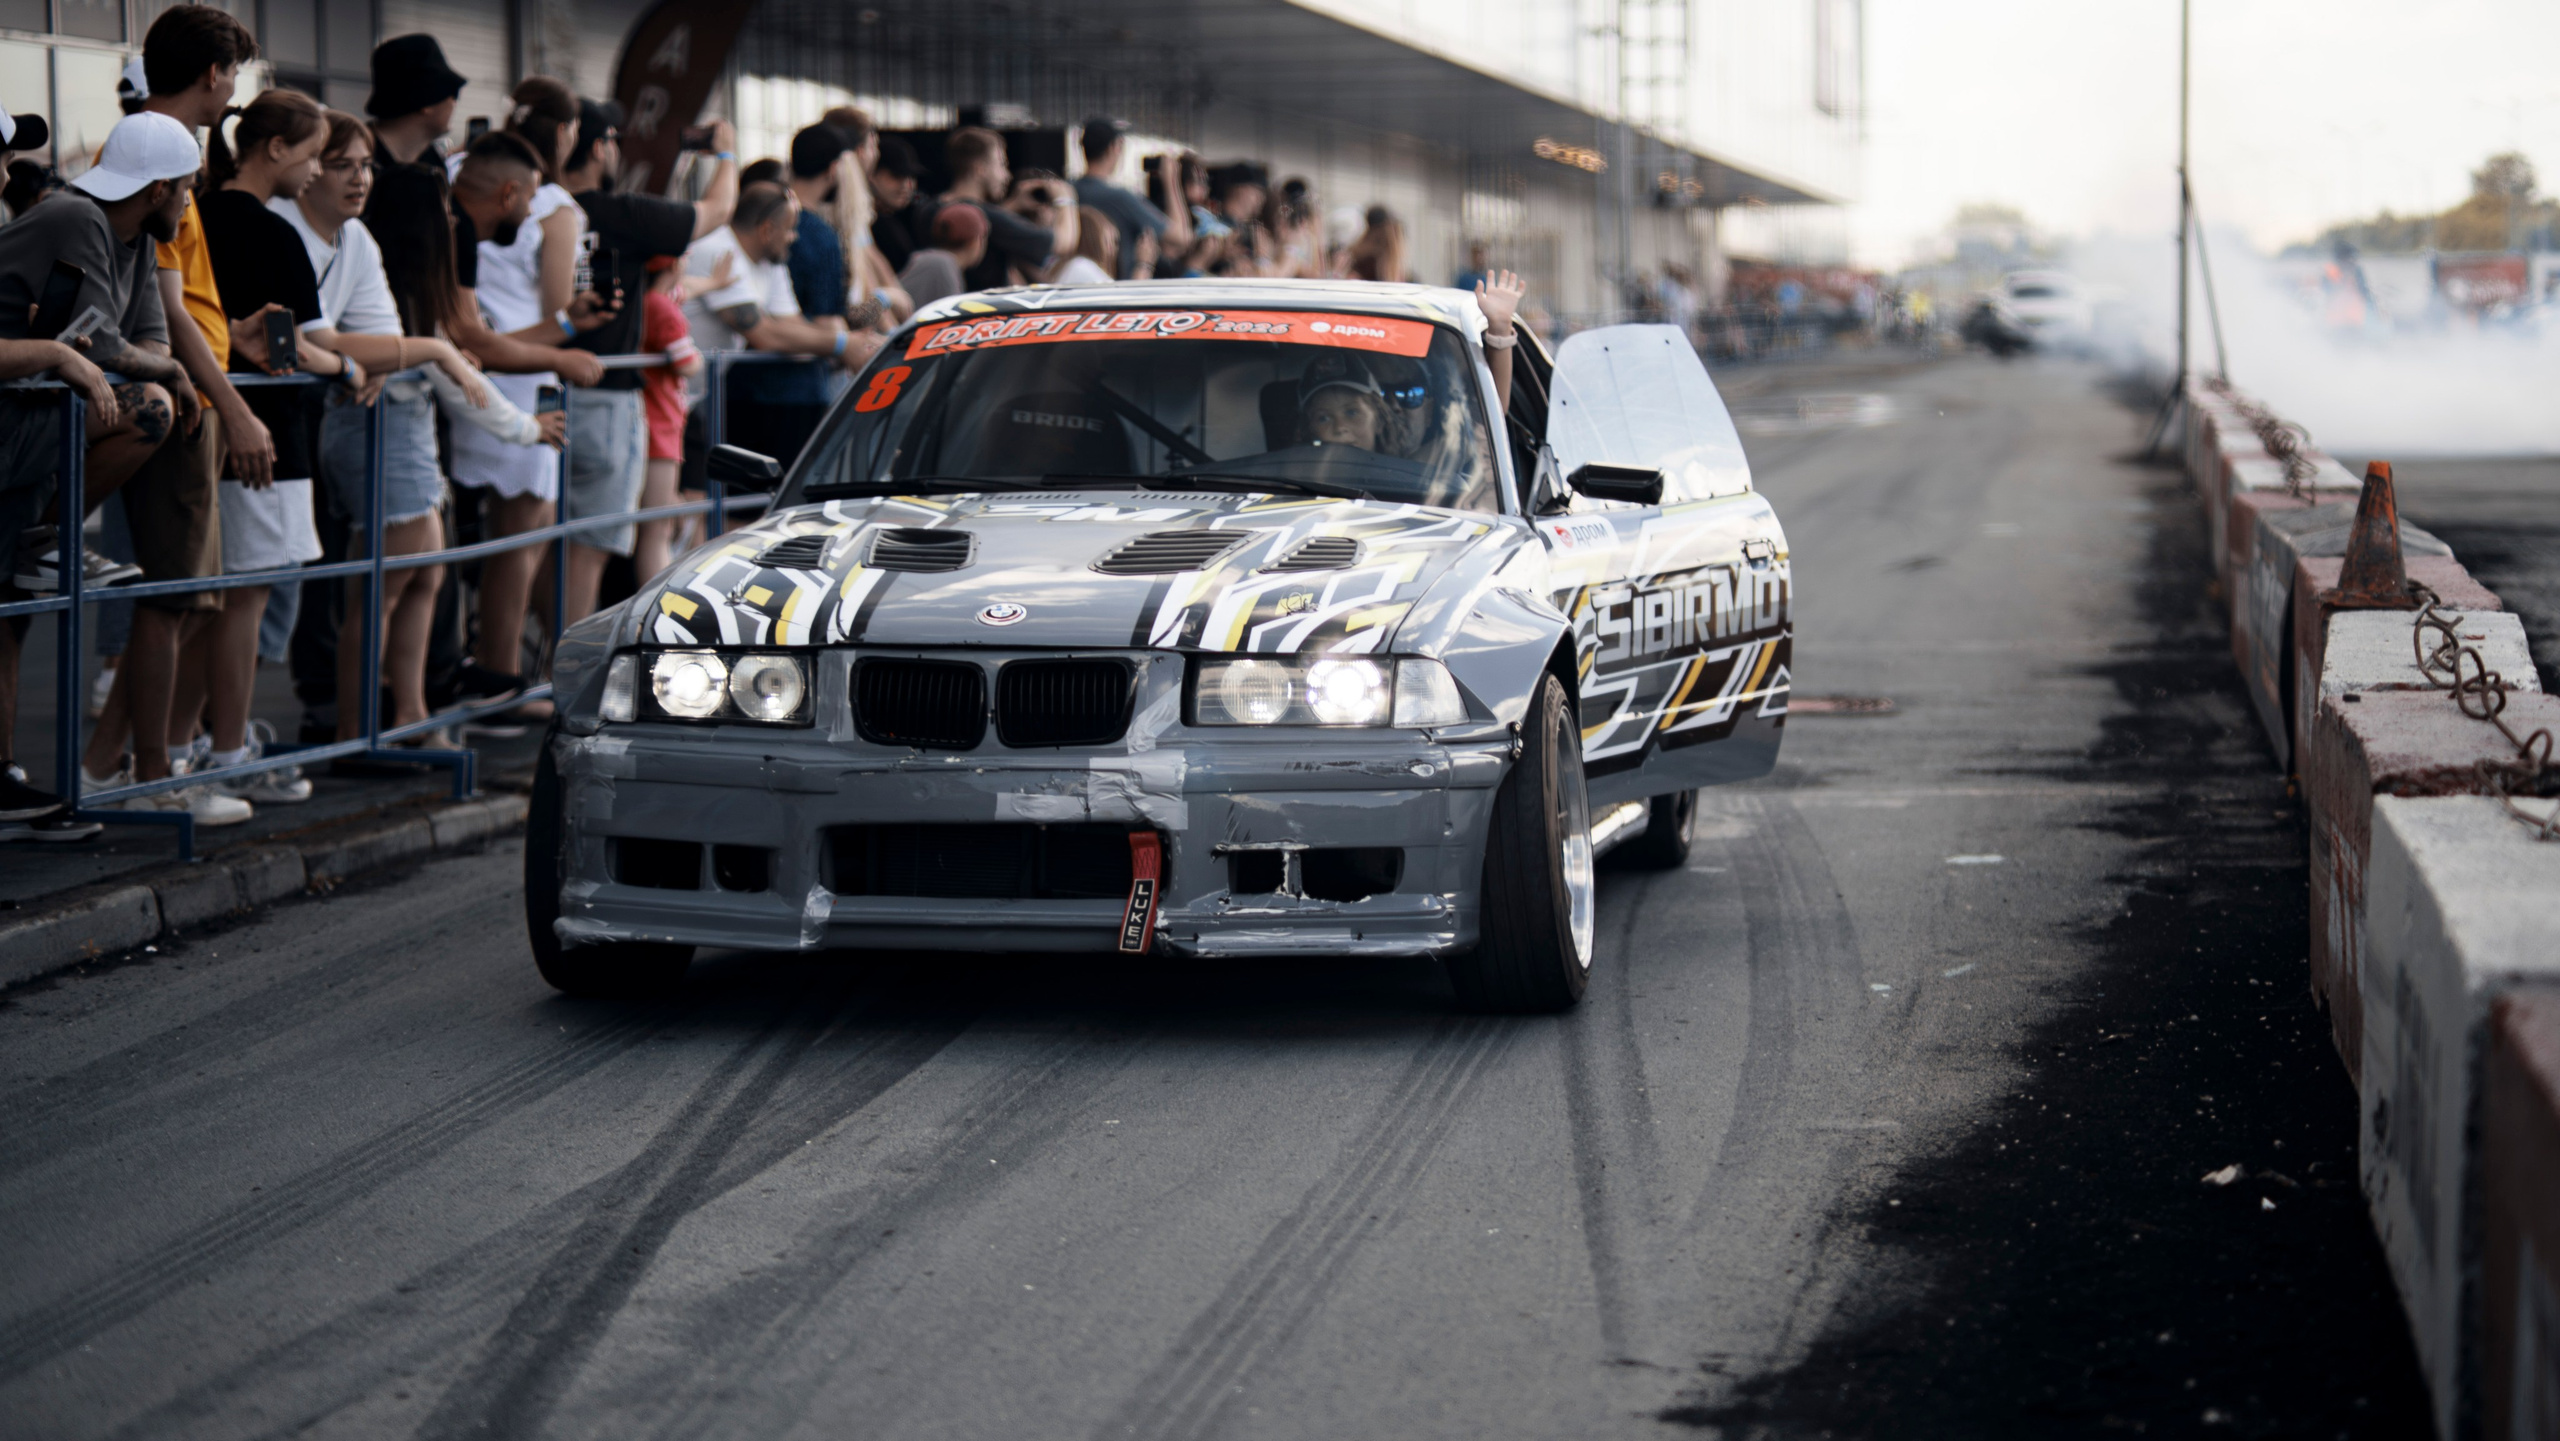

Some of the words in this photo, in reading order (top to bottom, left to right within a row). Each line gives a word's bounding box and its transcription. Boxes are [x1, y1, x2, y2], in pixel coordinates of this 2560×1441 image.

[925, 313, 1082, 349] DRIFT
[1075, 311, 1207, 336] LETO
[1211, 321, 1291, 335] 2026
[855, 366, 912, 412] 8
[1011, 408, 1105, 433] BRIDE
